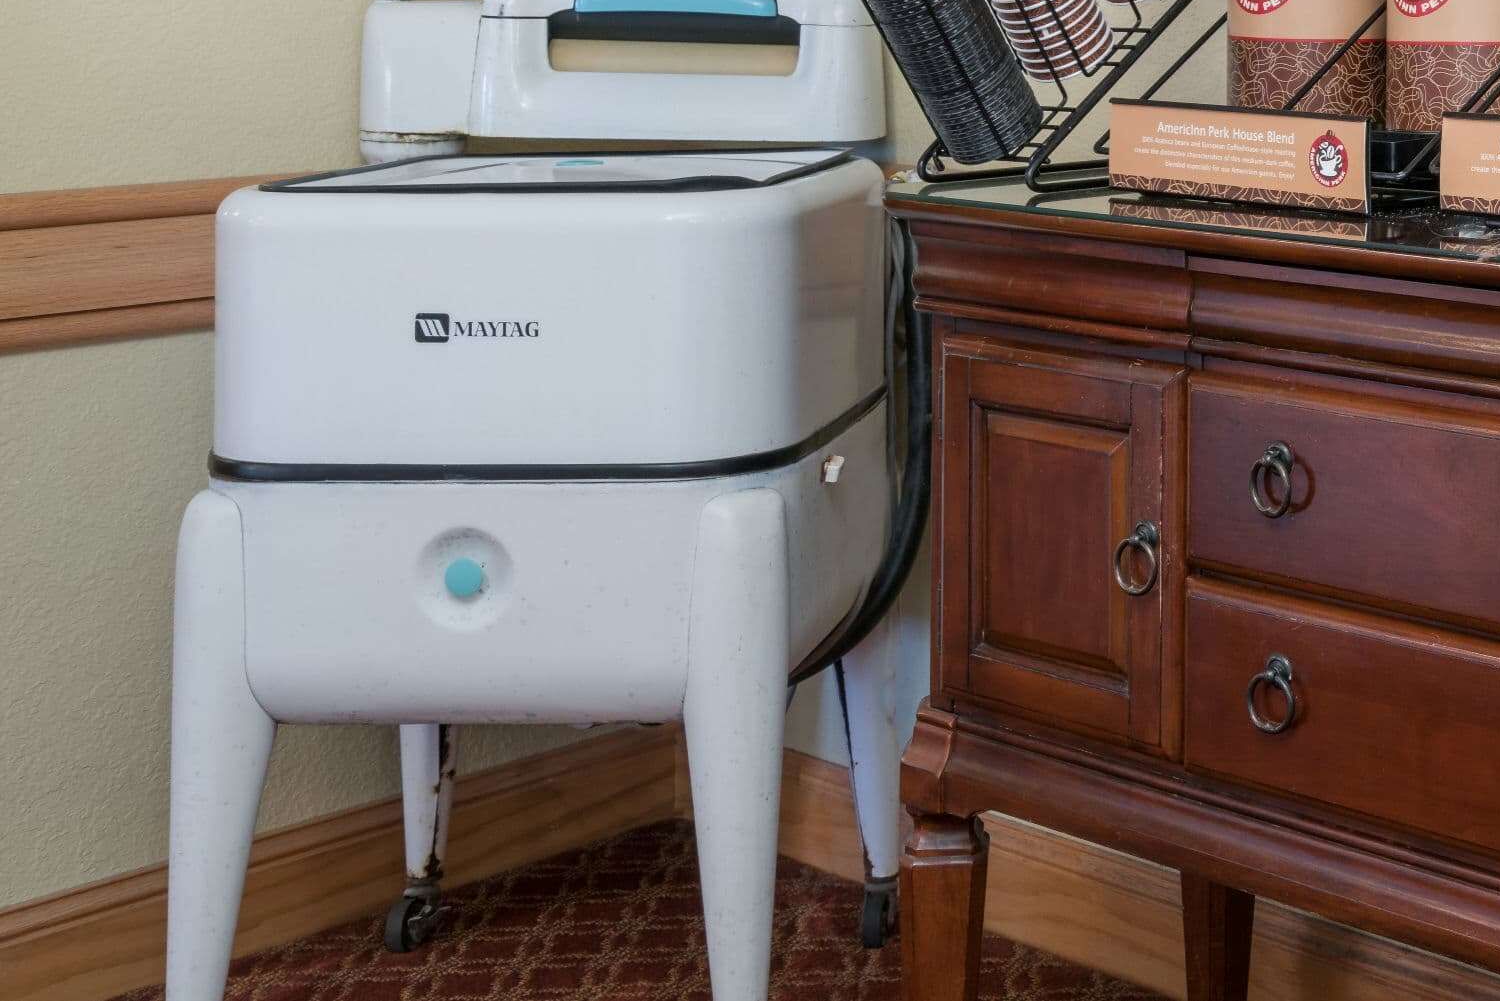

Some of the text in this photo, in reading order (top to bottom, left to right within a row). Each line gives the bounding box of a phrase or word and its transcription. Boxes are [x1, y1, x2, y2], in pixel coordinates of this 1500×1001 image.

[1157, 122, 1295, 145] AmericInn Perk House Blend
[1491, 166, 1500, 174] the
[453, 321, 540, 338] MAYTAG
